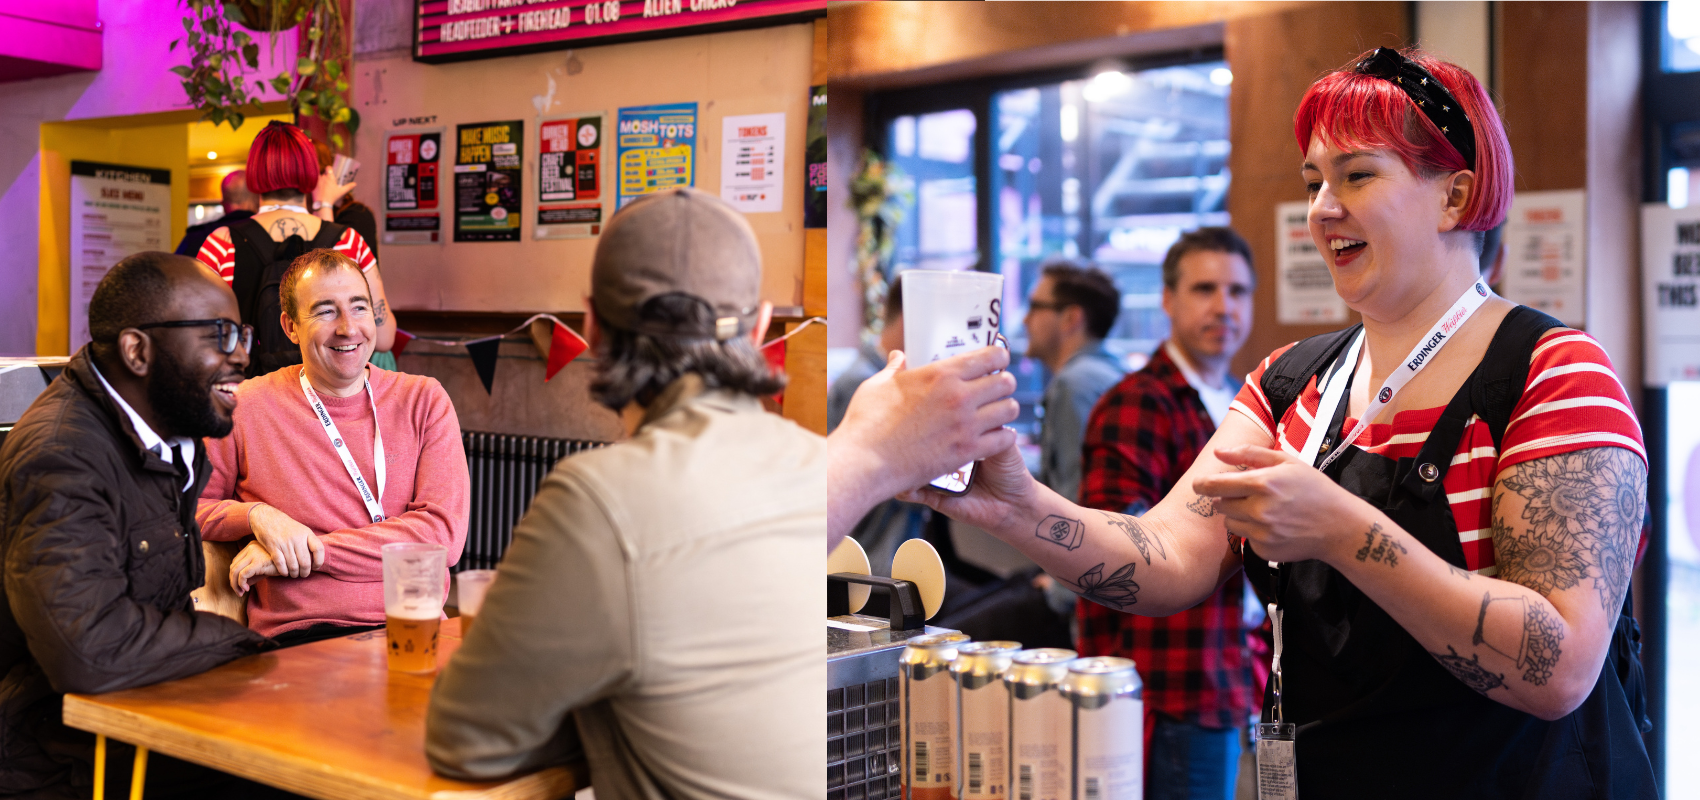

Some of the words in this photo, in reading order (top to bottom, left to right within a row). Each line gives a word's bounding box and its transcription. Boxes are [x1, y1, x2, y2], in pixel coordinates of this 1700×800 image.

[440, 16, 500, 42] HEADFEEDER
[518, 7, 571, 33] FIREHEAD
[585, 1, 620, 25] 01.08
[392, 118, 407, 126] UP
[408, 116, 438, 125] NEXT
[620, 119, 659, 134] MOSH
[482, 125, 510, 143] MUSIC
[659, 124, 694, 138] TOTS
[1407, 331, 1446, 372] ERDINGER
